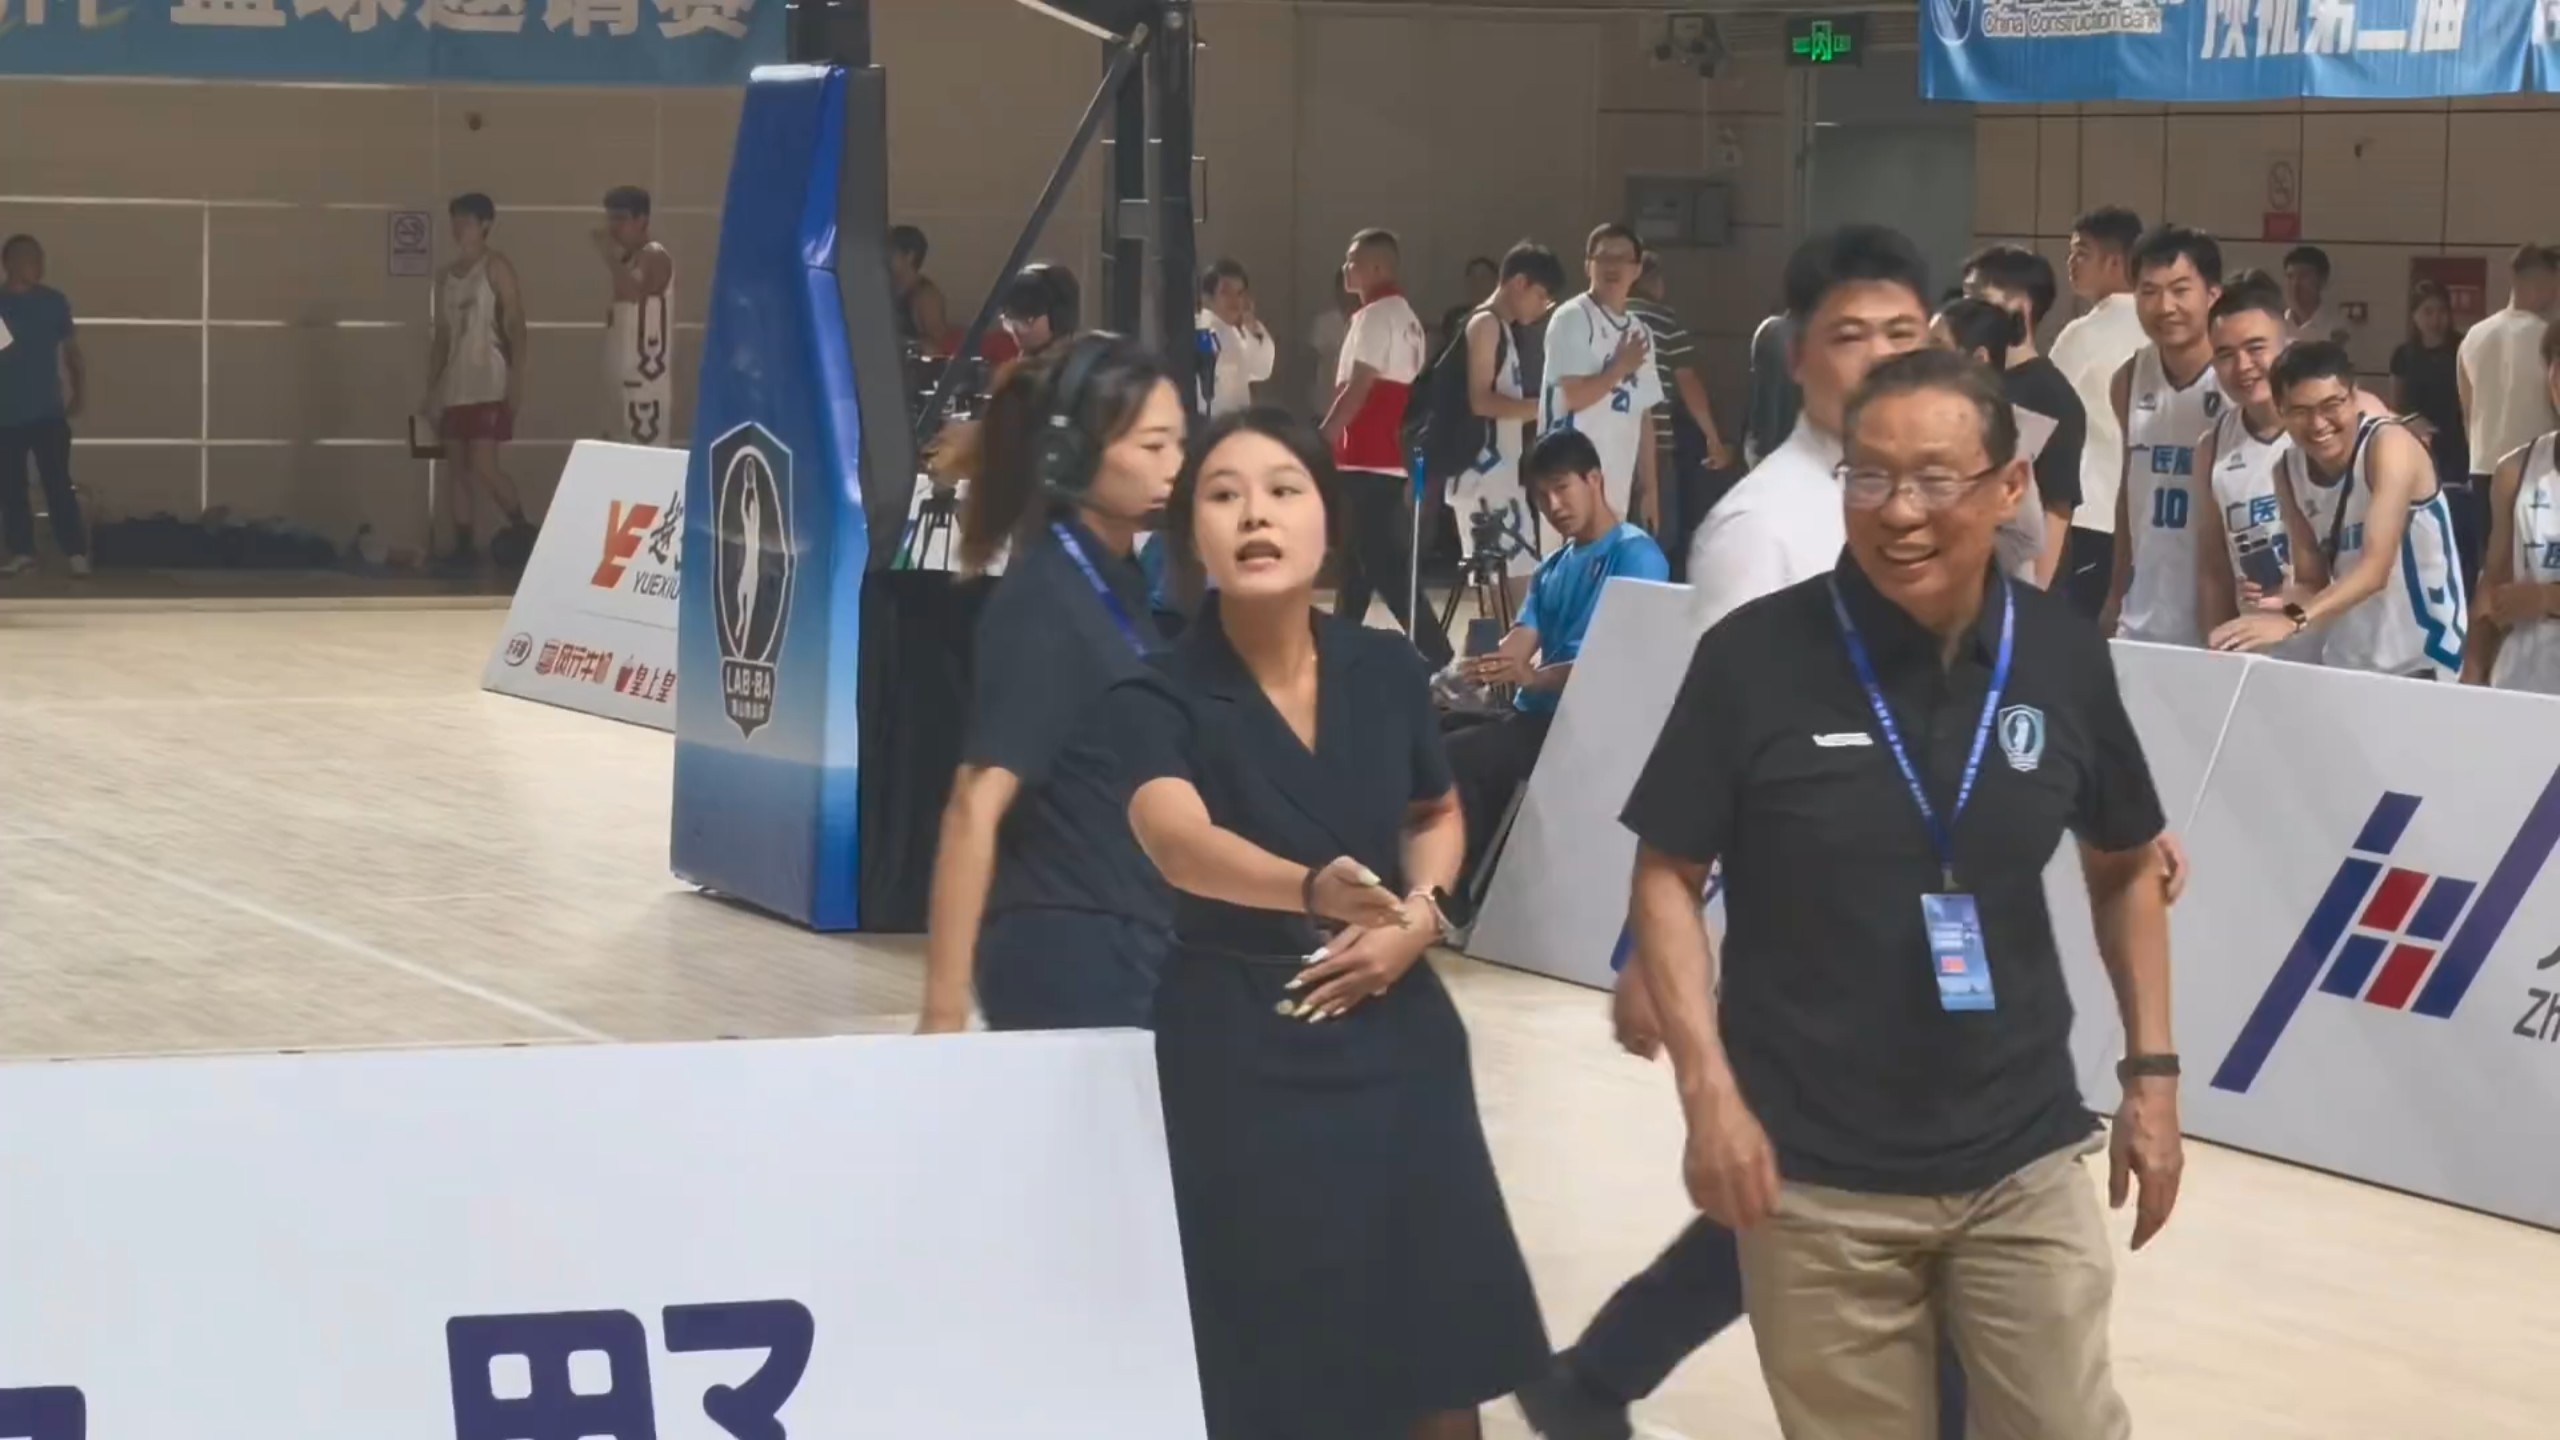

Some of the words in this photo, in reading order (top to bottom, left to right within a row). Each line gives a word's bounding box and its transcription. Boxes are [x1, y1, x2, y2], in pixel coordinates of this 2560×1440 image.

[1983, 9, 2025, 34] China
[2028, 8, 2118, 33] Construction
[2121, 7, 2161, 29] Bank
[2153, 487, 2188, 529] 10
